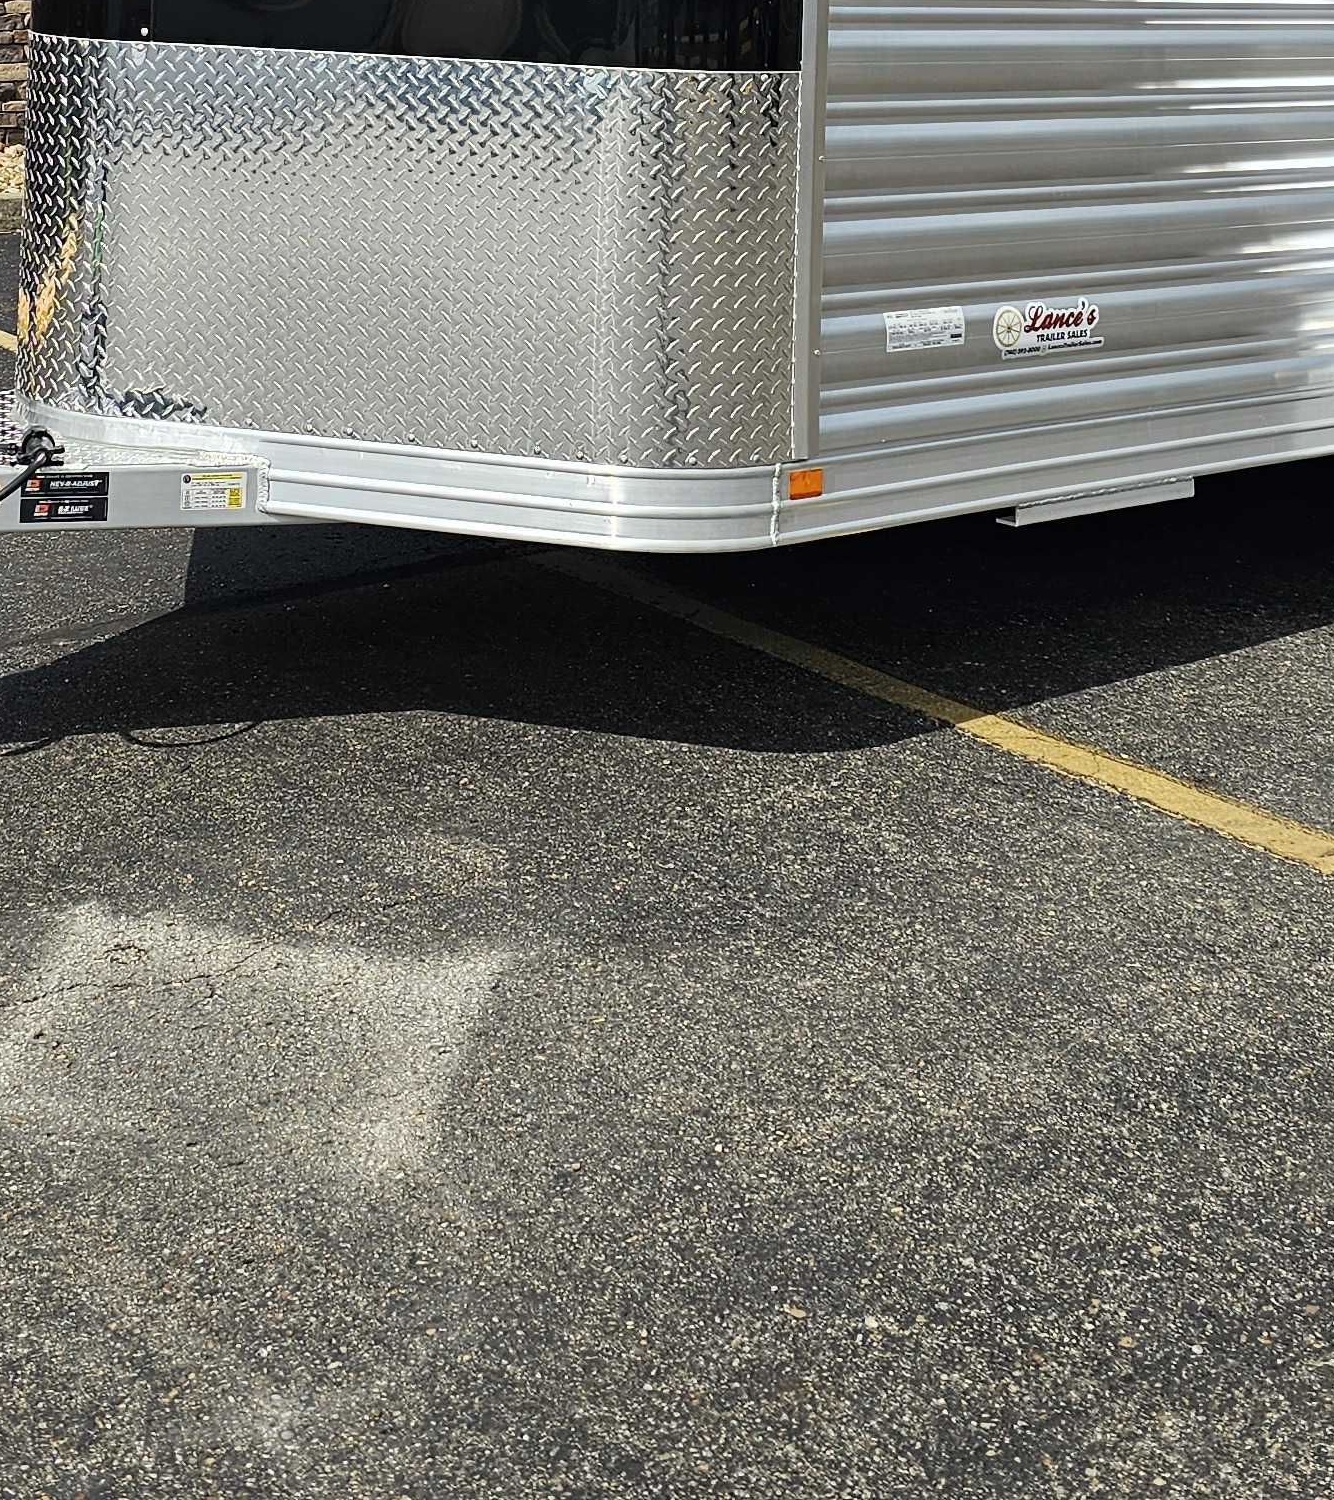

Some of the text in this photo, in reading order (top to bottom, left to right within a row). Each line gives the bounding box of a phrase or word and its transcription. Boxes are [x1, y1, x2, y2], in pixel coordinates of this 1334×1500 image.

[1023, 300, 1097, 334] Lance's
[1036, 328, 1088, 343] TRAILER SALES
